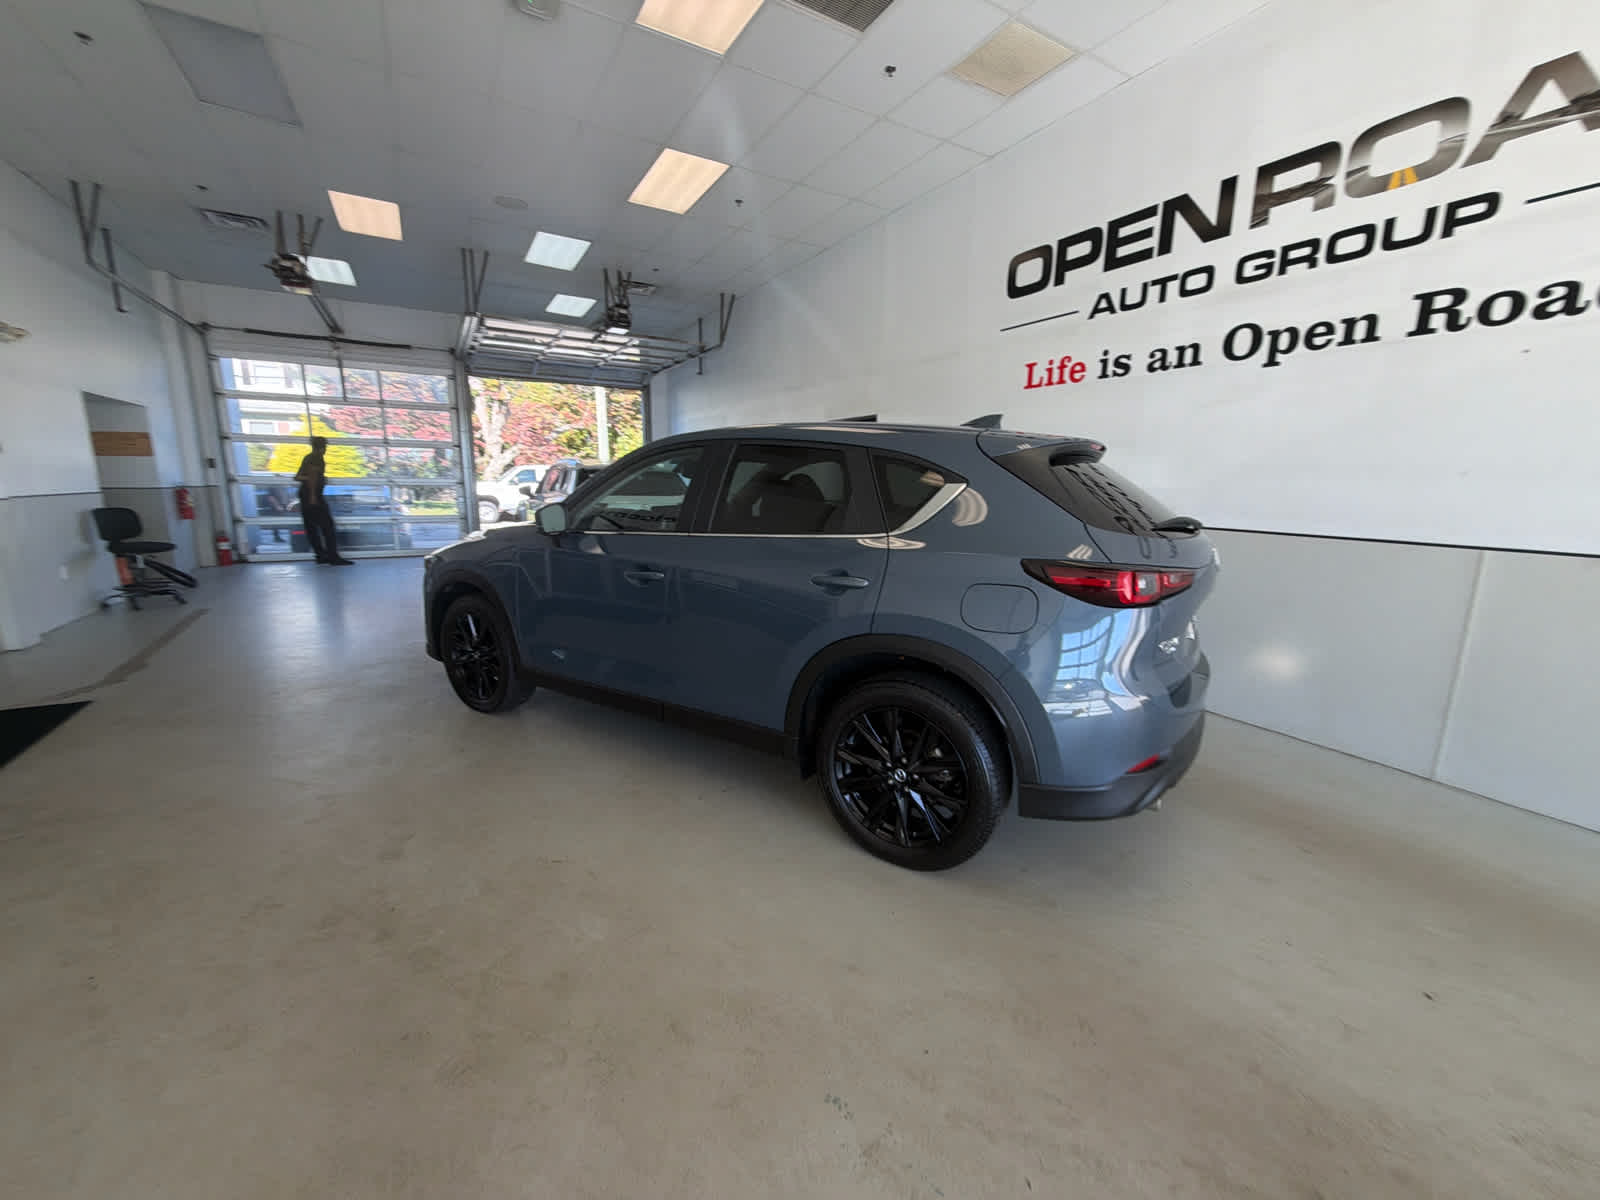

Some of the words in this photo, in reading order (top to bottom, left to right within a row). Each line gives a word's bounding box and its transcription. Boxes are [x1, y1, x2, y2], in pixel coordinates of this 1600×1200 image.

[1087, 264, 1216, 321] AUTO
[1234, 191, 1502, 285] GROUP
[1023, 355, 1087, 390] Life
[1097, 349, 1133, 380] is
[1146, 342, 1203, 374] an
[1222, 312, 1381, 369] Open
[1405, 280, 1600, 338] Roa
